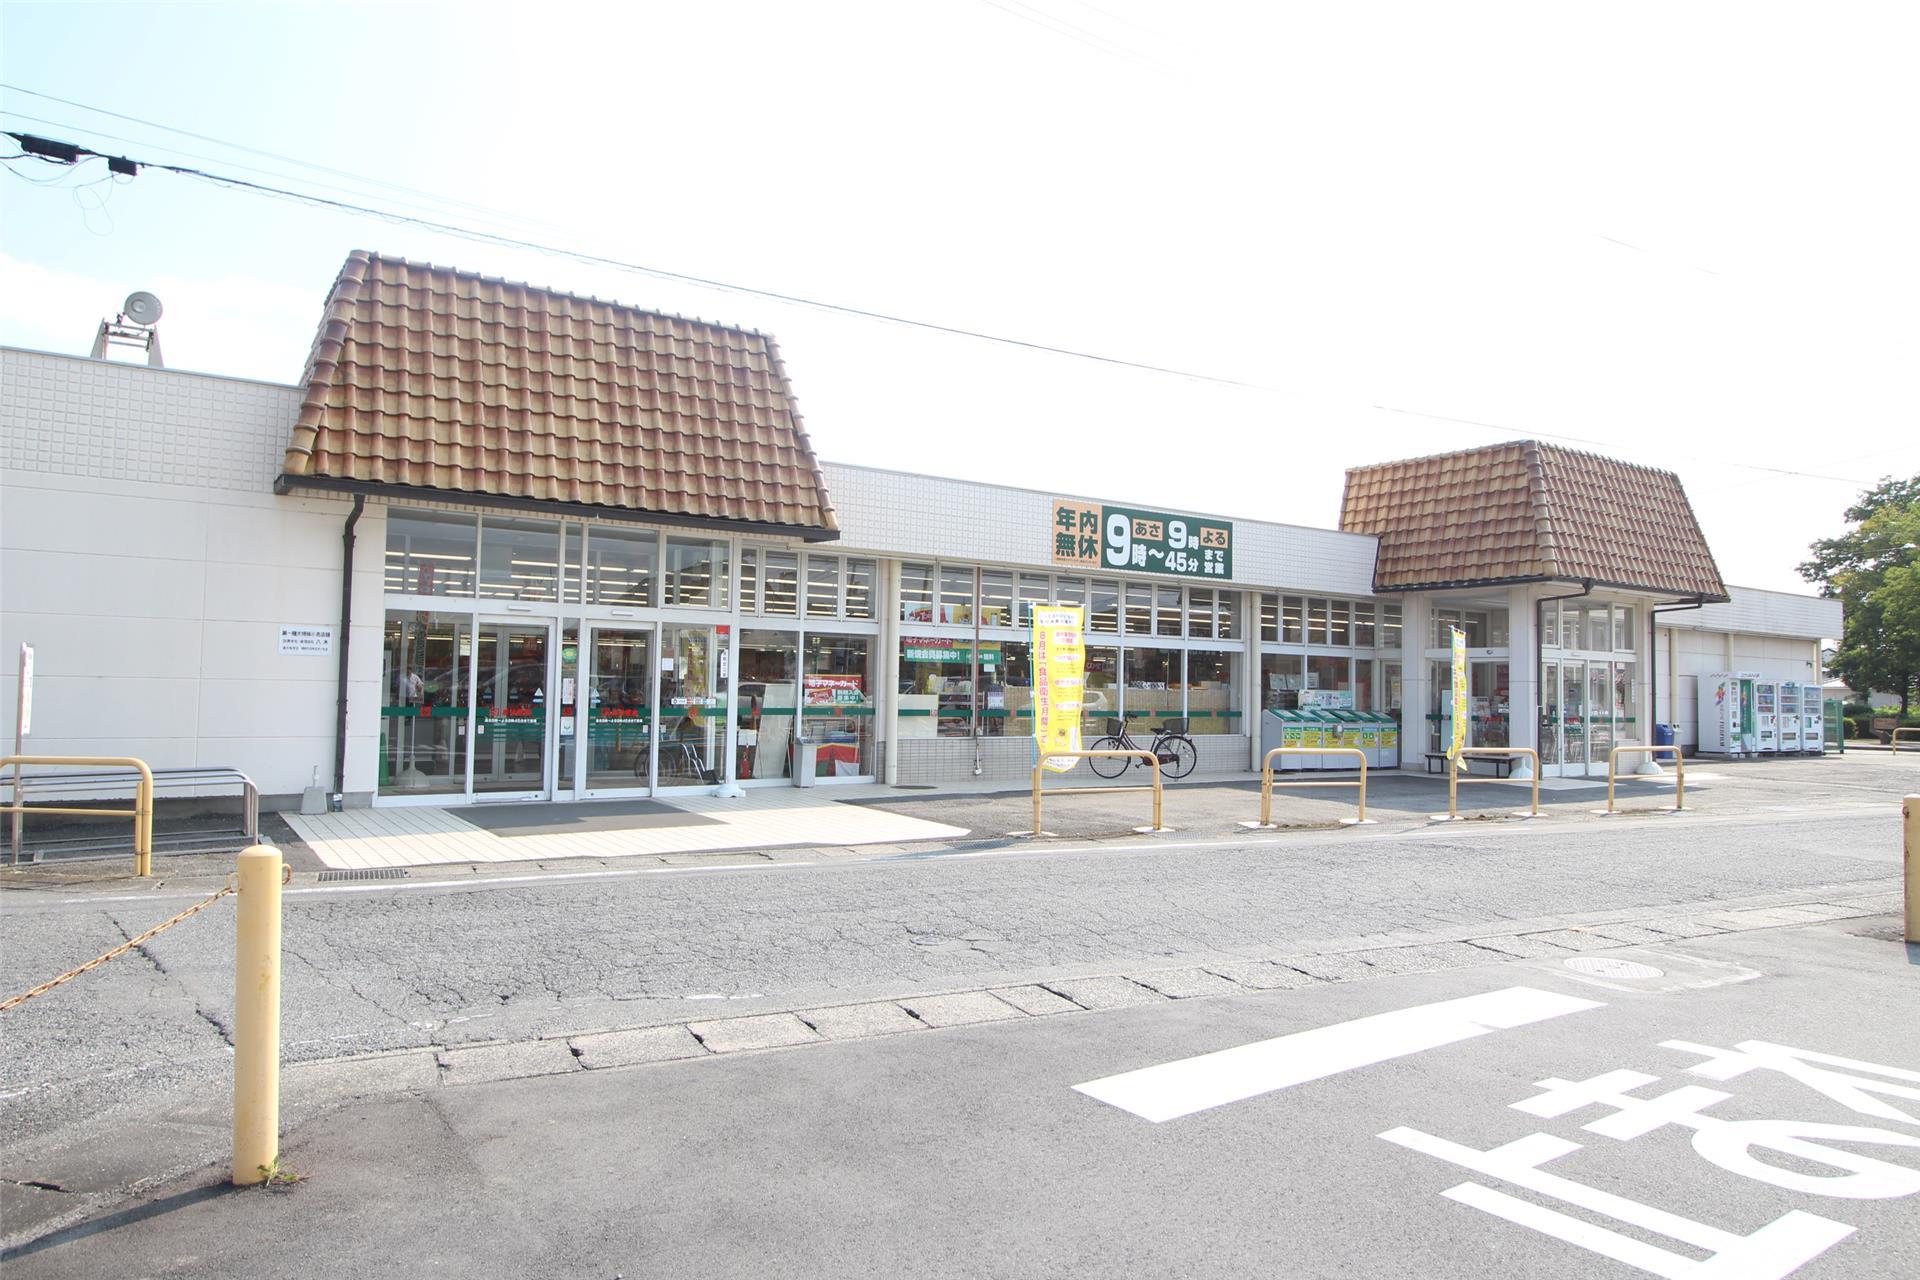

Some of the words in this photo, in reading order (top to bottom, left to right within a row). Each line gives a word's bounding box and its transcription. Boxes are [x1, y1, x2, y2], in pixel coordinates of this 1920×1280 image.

[1056, 506, 1099, 534] 年内
[1134, 521, 1161, 538] あさ
[1202, 530, 1226, 546] よる
[1055, 532, 1099, 559] 無休
[1164, 551, 1199, 572] 45分
[1204, 549, 1225, 563] まで
[1204, 561, 1225, 575] 営業
